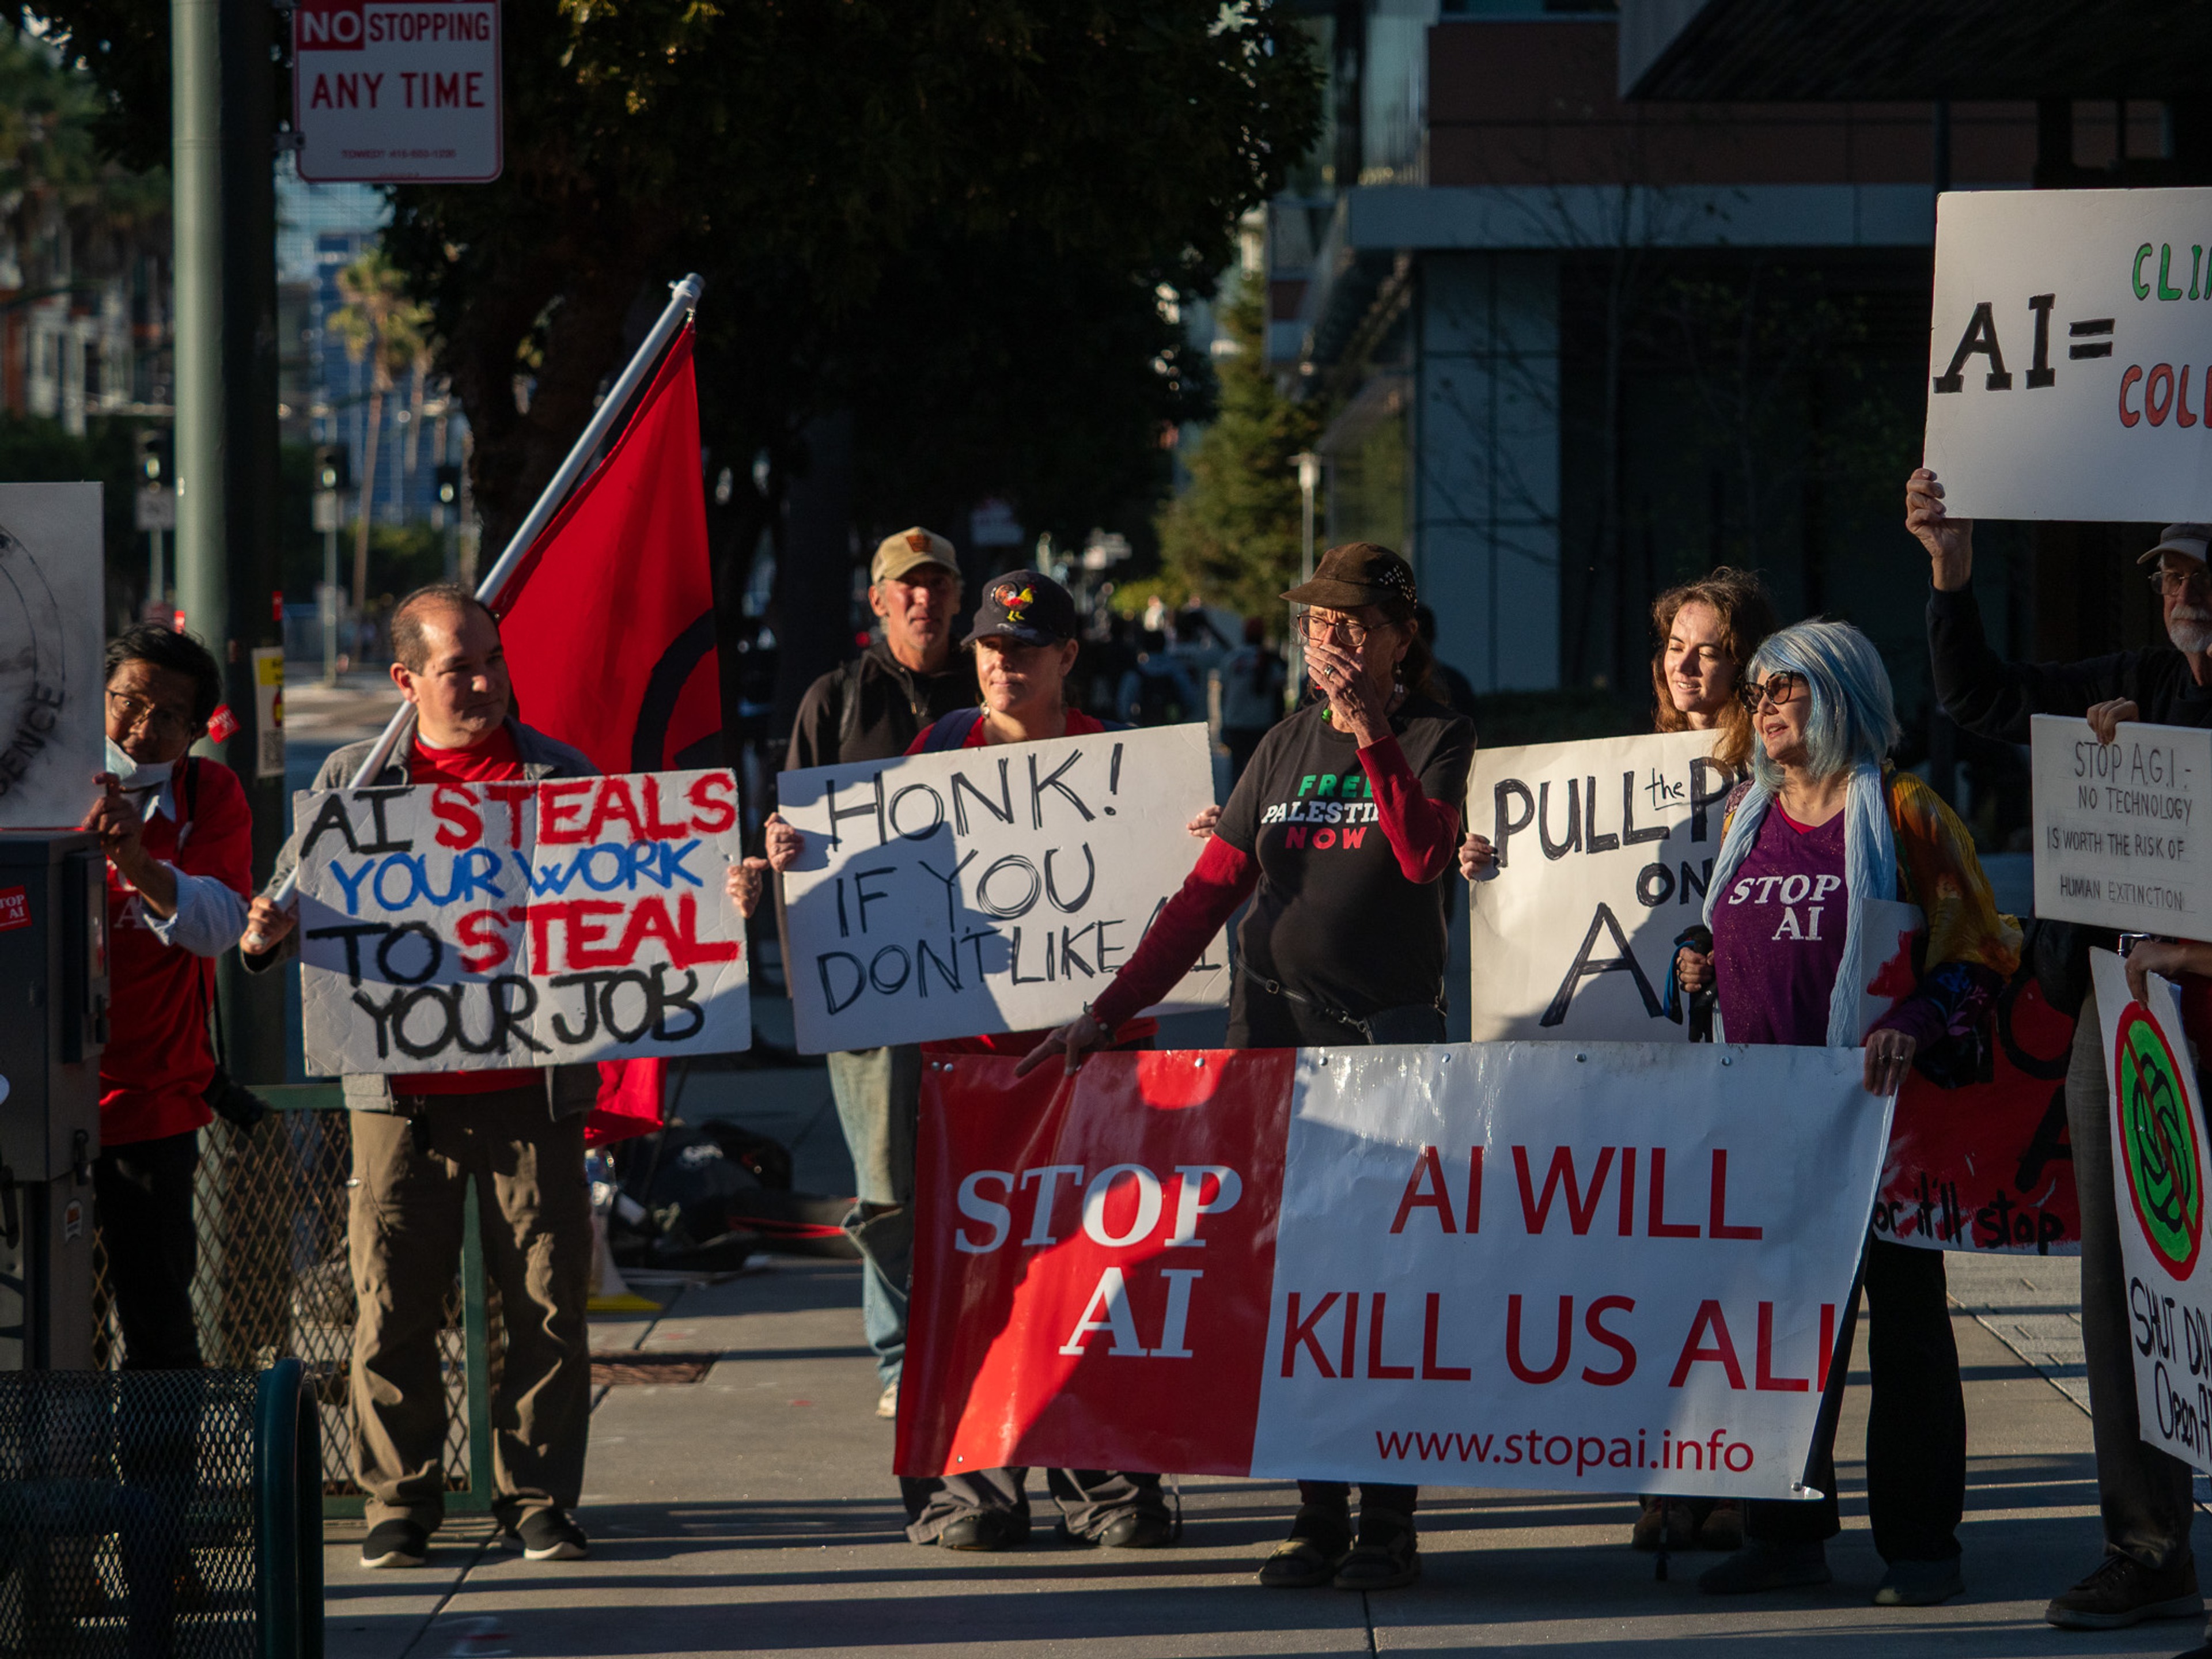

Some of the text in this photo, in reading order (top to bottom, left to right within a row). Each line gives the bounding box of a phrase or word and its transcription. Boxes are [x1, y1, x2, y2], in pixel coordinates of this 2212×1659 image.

[304, 10, 490, 43] NO STOPPING
[310, 71, 485, 109] ANY TIME
[2132, 242, 2212, 301] CLI
[2074, 741, 2123, 784] STOP
[300, 772, 737, 857] AI STEALS
[825, 742, 1124, 851] HONK!
[1494, 771, 1670, 868] PULL
[1645, 767, 1685, 809] the
[2078, 785, 2193, 827] NO TECHNOLOGY
[1285, 826, 1368, 850] NOW
[2047, 825, 2185, 861] IS WORTH THE RISK OF
[0, 894, 25, 909] TOP
[330, 839, 704, 915] YOUR WORK
[836, 842, 1095, 938] IF YOU
[1637, 858, 1713, 908] ON
[1728, 874, 1842, 905] STOP
[2060, 874, 2184, 911] HUMAN EXTINCTION
[113, 895, 146, 929] A
[306, 891, 741, 987] TO STEAL
[1771, 906, 1824, 941] AI
[817, 926, 1003, 1016] DON'T
[1011, 919, 1126, 986] LIKE
[1539, 902, 1665, 1028] A
[353, 961, 705, 1059] YOUR JOB
[954, 1163, 1243, 1254] STOP
[1389, 1145, 1763, 1240] AI WILL
[1873, 1200, 1903, 1233] or
[1976, 1189, 2065, 1256] stop
[1058, 1266, 1204, 1358] AI
[1280, 1291, 1472, 1381] KILL
[1505, 1294, 1637, 1387] US
[2131, 1277, 2212, 1384] SHUT DO
[1375, 1427, 1754, 1478] www.stopai.info
